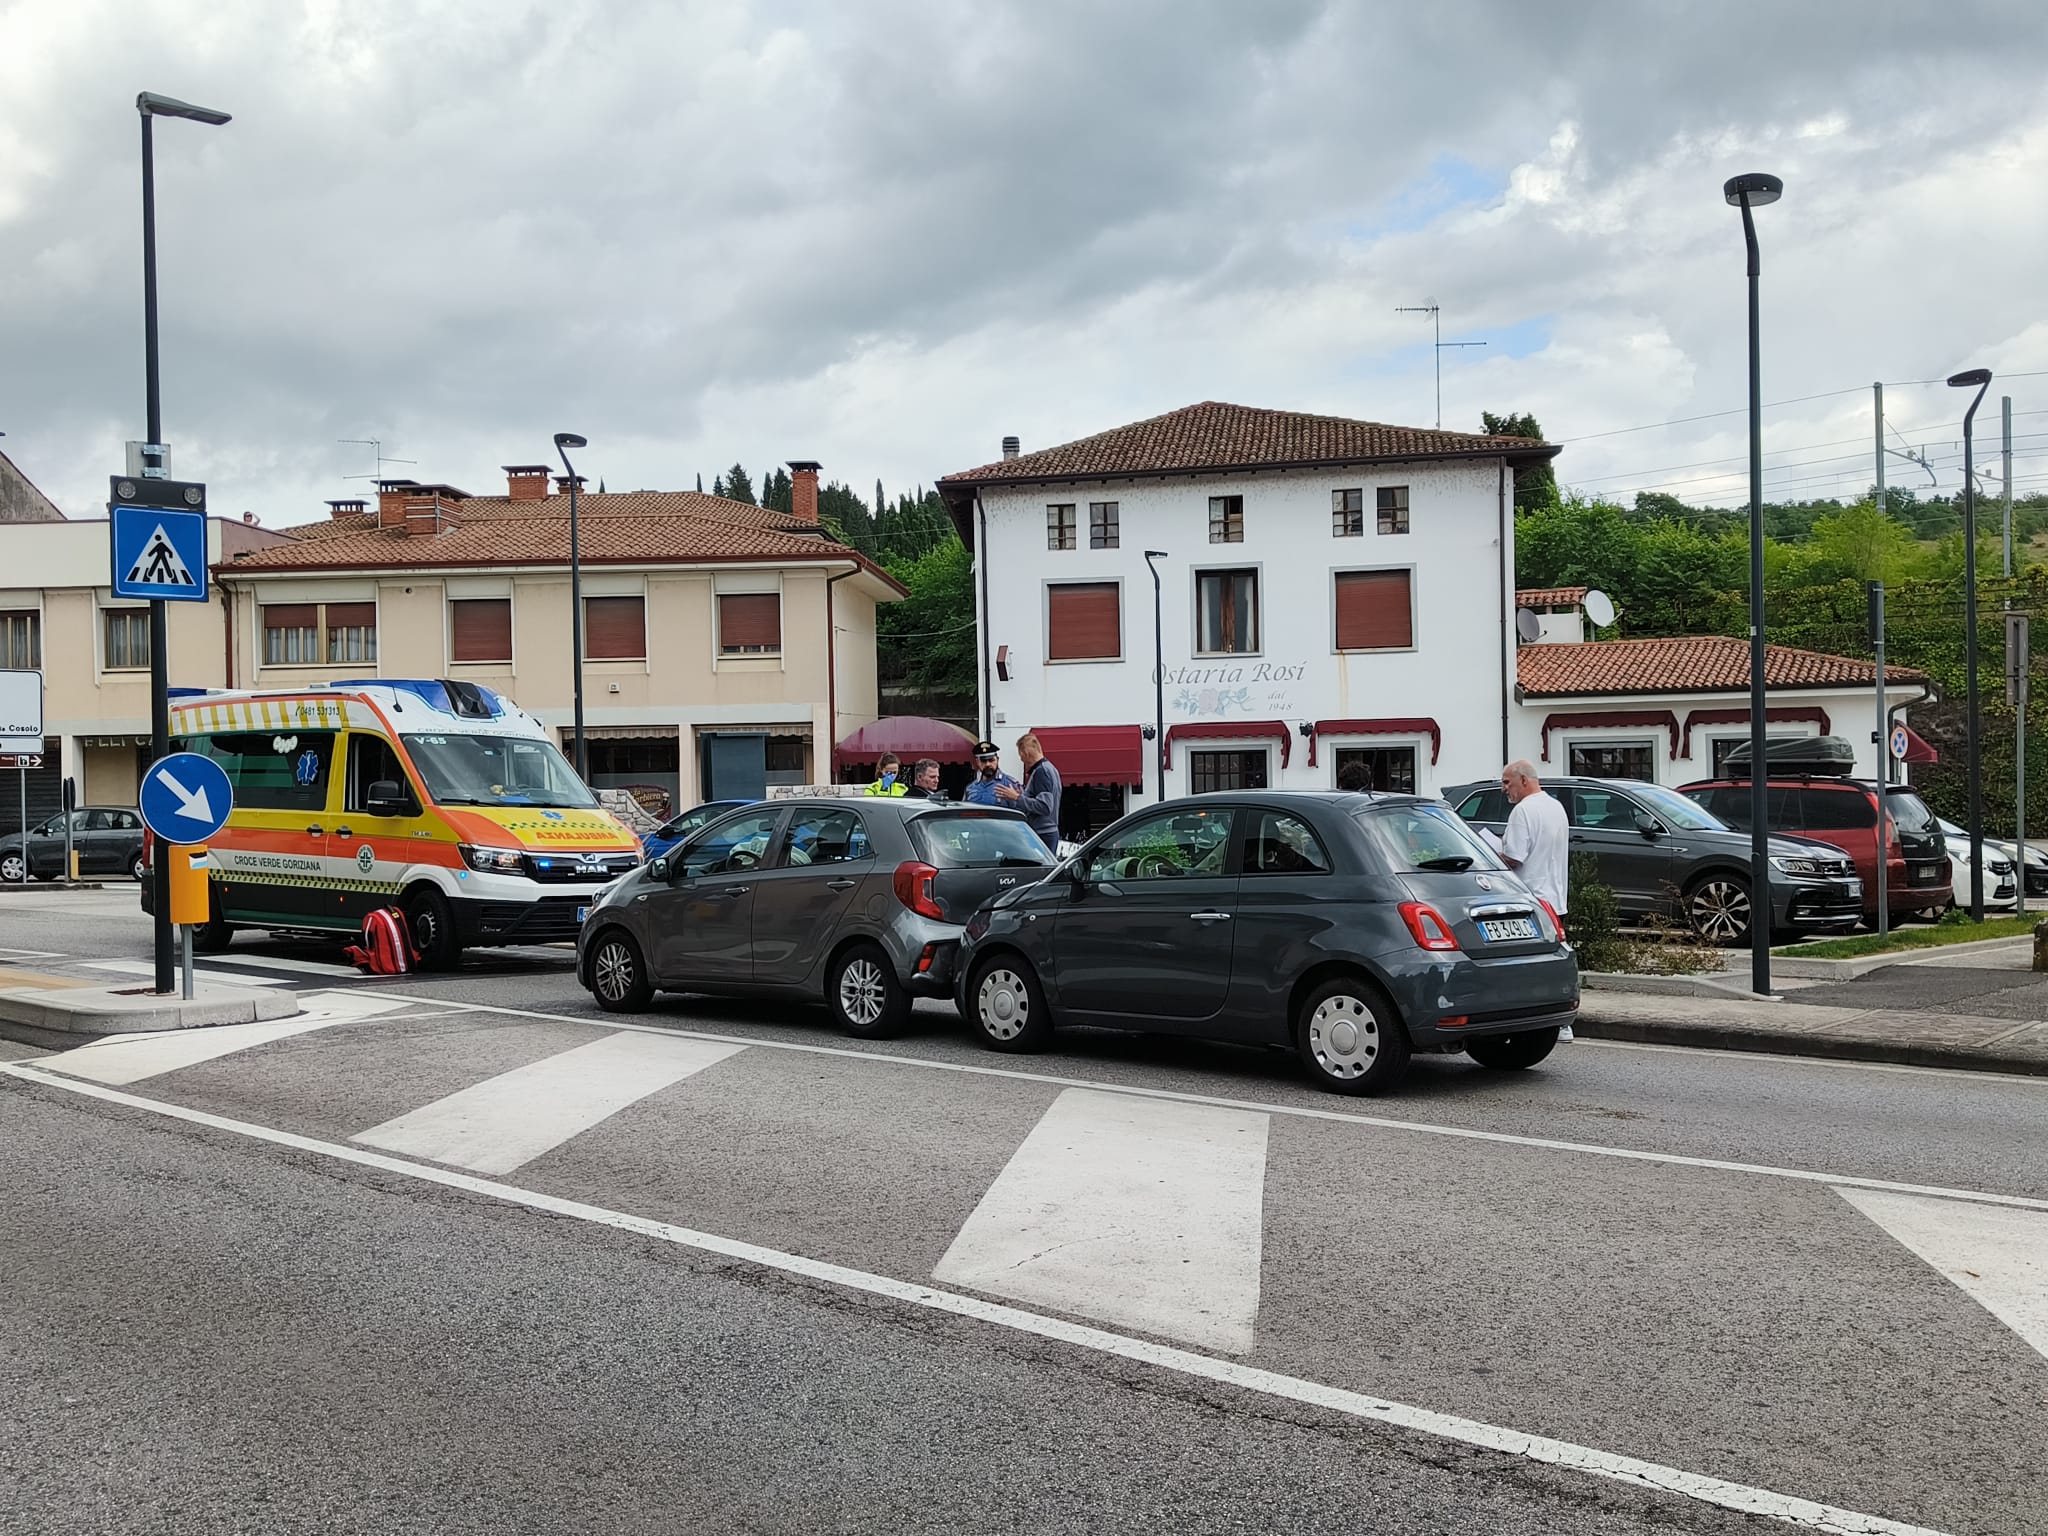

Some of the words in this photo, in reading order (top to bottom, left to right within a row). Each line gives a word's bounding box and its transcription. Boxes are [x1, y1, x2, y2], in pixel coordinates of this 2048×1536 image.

[1152, 662, 1243, 685] Ostaria
[1267, 690, 1286, 700] dal
[300, 706, 315, 716] 0481
[317, 706, 340, 716] 531313
[1268, 703, 1293, 711] 1948
[9, 724, 38, 732] Cosolo
[414, 736, 447, 745] V-65
[634, 792, 661, 803] arbiera
[234, 855, 258, 866] CROCE
[259, 857, 281, 868] VERDE
[282, 859, 321, 871] GORIZIANA
[575, 865, 608, 874] MAN
[1485, 922, 1502, 939] FB
